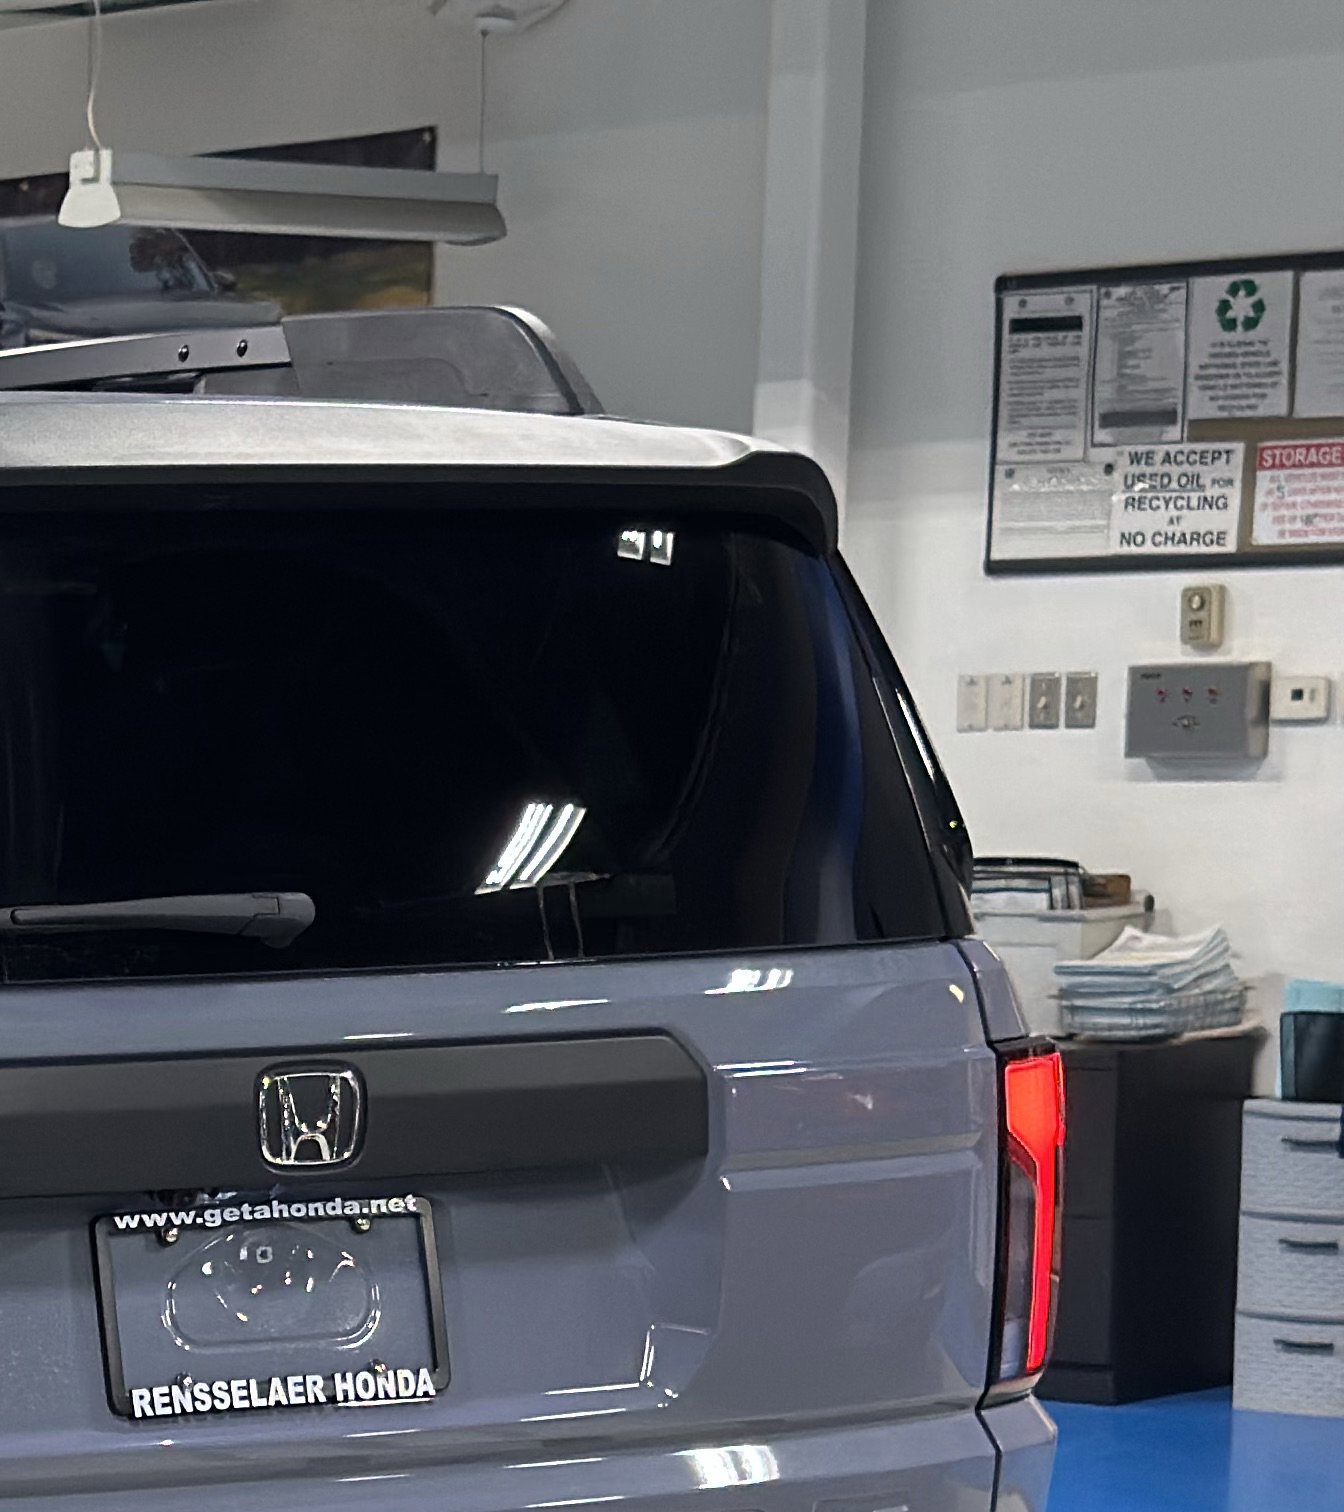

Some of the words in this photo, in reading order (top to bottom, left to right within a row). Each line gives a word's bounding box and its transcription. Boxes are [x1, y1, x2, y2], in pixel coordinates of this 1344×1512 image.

[1128, 450, 1155, 467] WE
[1160, 449, 1235, 466] ACCEPT
[1262, 447, 1343, 467] STORAGE
[1123, 474, 1172, 490] USED
[1177, 473, 1206, 490] OIL
[1123, 494, 1229, 512] RECYCLING
[1119, 532, 1146, 548] NO
[1151, 531, 1227, 547] CHARGE
[113, 1195, 417, 1229] www.getahonda.net
[130, 1373, 325, 1419] RENSSELAER
[334, 1367, 436, 1405] HONDA
